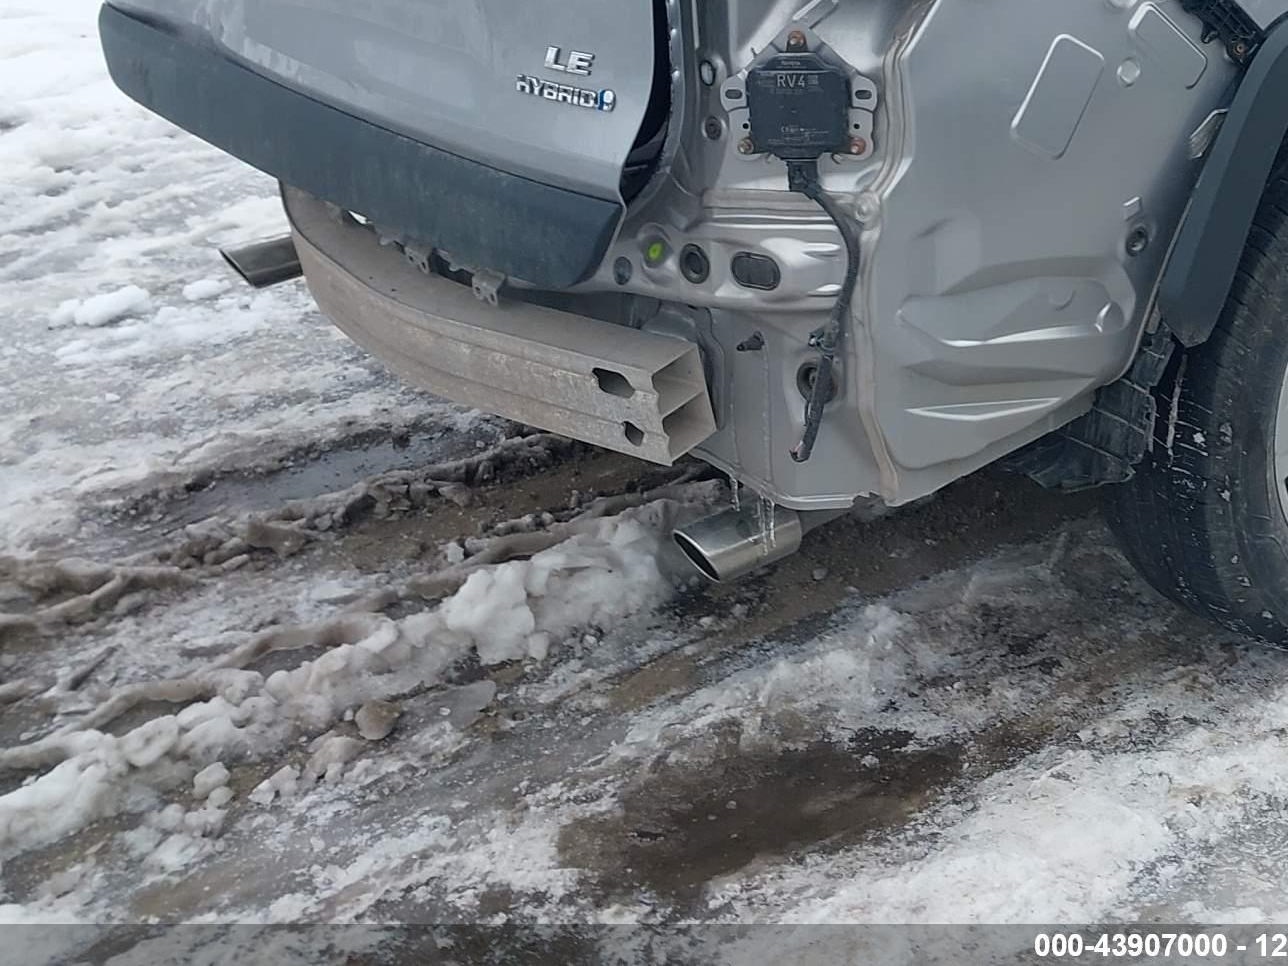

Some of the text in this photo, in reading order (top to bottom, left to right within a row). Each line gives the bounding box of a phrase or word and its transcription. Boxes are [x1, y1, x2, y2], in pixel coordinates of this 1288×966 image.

[544, 45, 595, 76] LE
[516, 74, 597, 108] HYBRID
[776, 75, 806, 88] RV4
